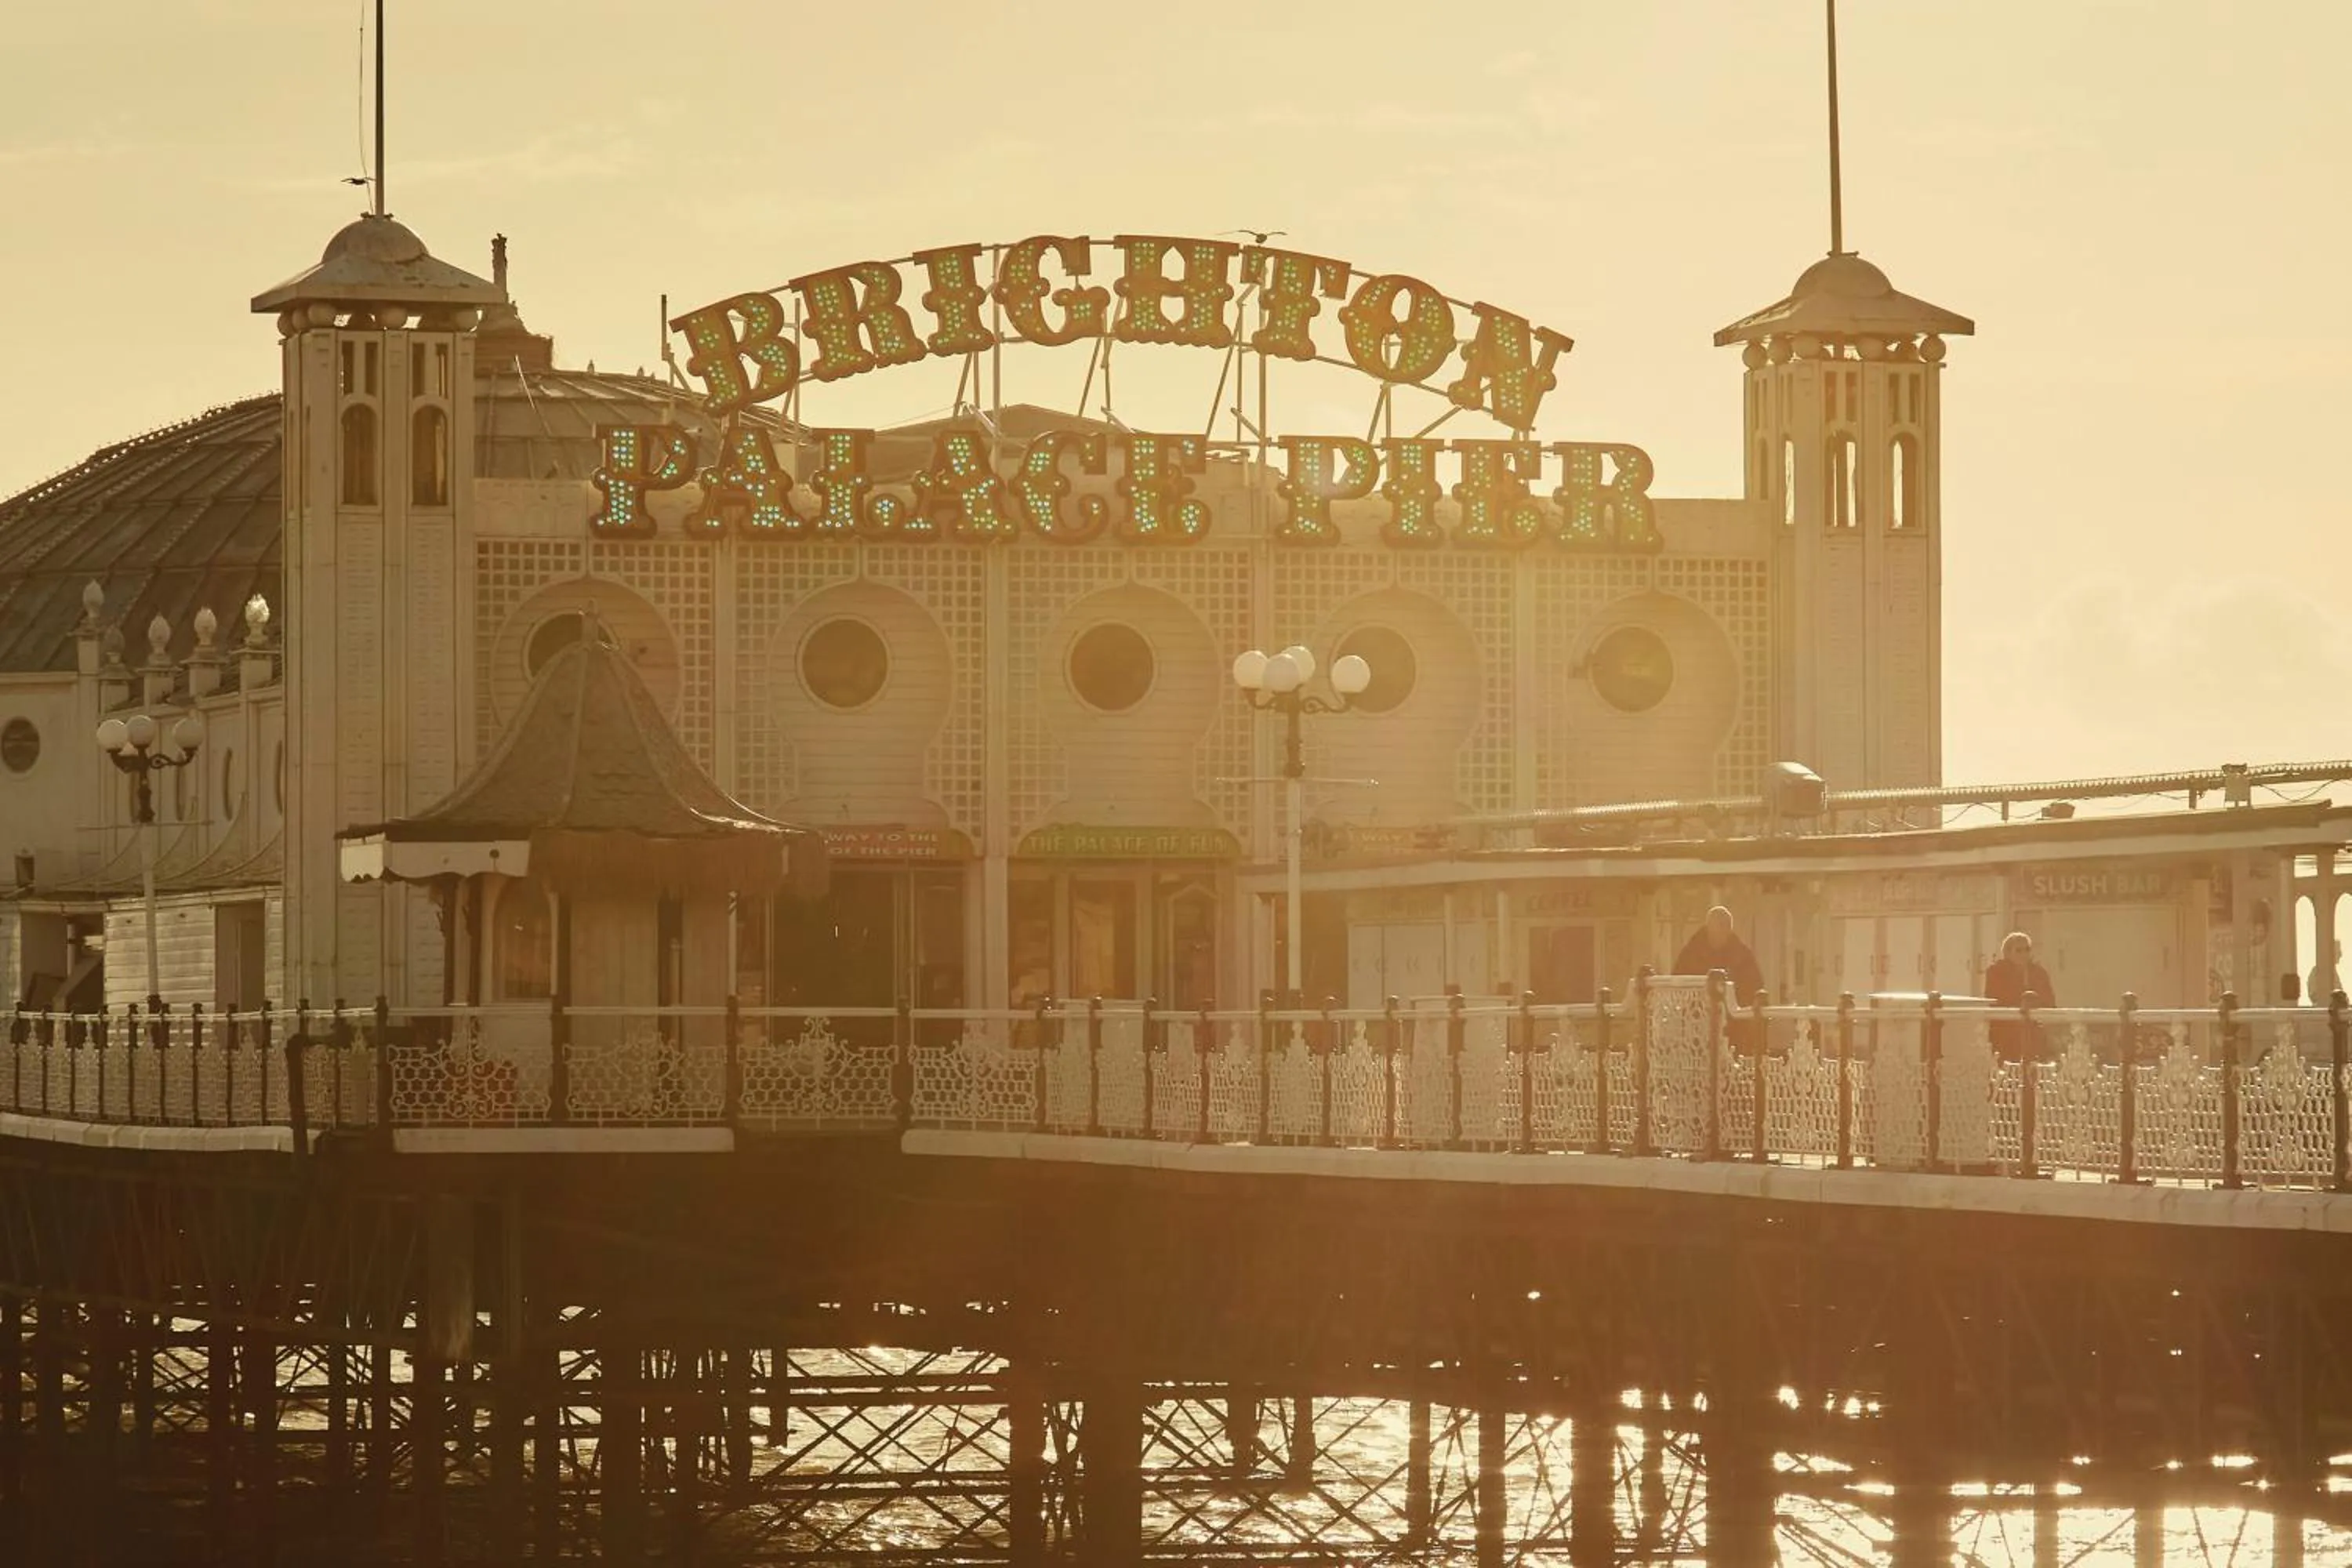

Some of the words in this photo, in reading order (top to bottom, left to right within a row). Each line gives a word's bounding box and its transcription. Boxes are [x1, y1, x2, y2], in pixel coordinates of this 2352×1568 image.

[669, 234, 1574, 431] BRIGHTON
[593, 424, 1208, 542] PALACE
[1276, 435, 1663, 550] PIER
[829, 833, 869, 842] WAY
[909, 833, 939, 843] THE
[1029, 835, 1066, 854] THE
[1073, 835, 1147, 853] PALACE
[1189, 836, 1229, 855] FUN
[898, 847, 938, 857] PIER
[2033, 875, 2109, 896] SLUSH
[2118, 874, 2161, 895] BAR
